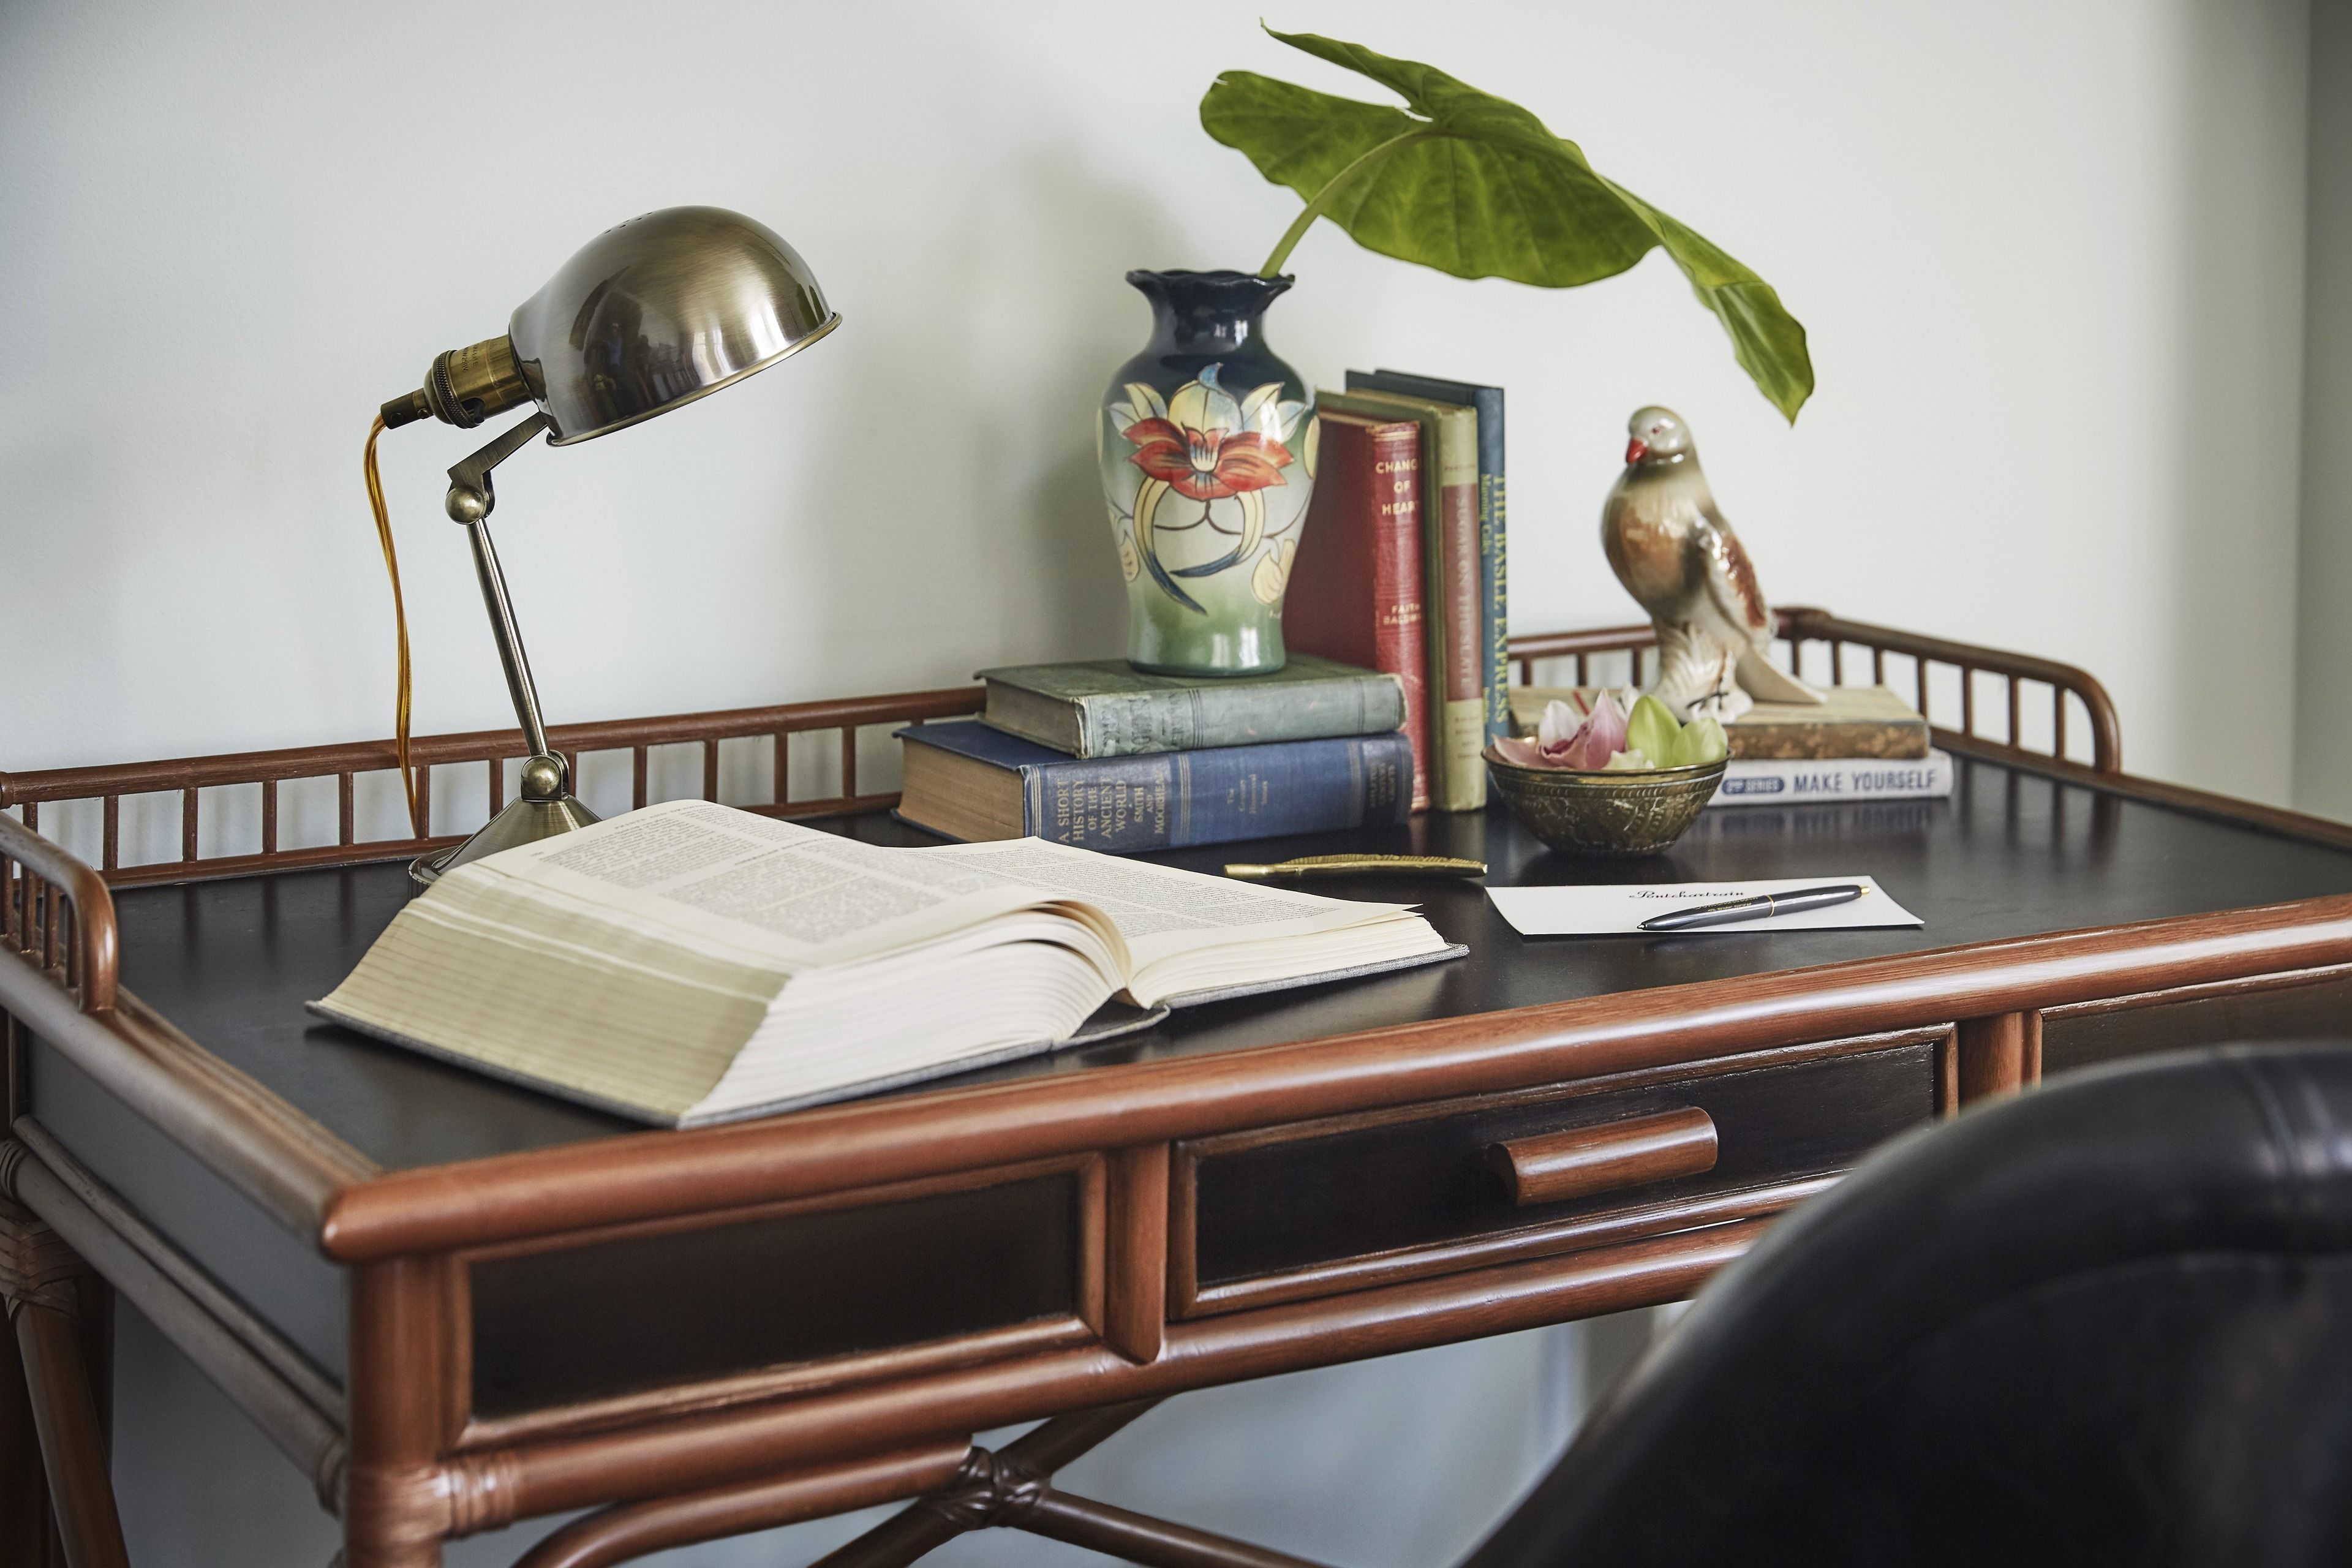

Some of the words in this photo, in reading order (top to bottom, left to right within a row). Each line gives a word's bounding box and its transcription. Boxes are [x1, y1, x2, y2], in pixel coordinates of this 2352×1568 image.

[1375, 458, 1418, 475] CHANG
[1393, 480, 1411, 494] OF
[1493, 477, 1506, 526] THE
[1382, 500, 1419, 516] HEAR
[1457, 497, 1471, 556] SUGAR
[1457, 559, 1472, 586] ON
[1493, 533, 1507, 609] BASLE
[1458, 594, 1472, 630] THE
[1459, 634, 1473, 687] SLATE
[1494, 617, 1509, 723] EXPRESS
[1088, 786, 1097, 812] THE
[1793, 771, 1842, 793] MAKE
[1852, 769, 1936, 791] YOURSELF
[1058, 778, 1070, 826] SHORT
[1072, 779, 1085, 841] HISTORY
[1101, 776, 1112, 839] ANCIENT
[1115, 780, 1127, 832] WORLD
[1134, 787, 1144, 823] SMITH
[1058, 832, 1069, 843] A
[1088, 815, 1097, 831] OF
